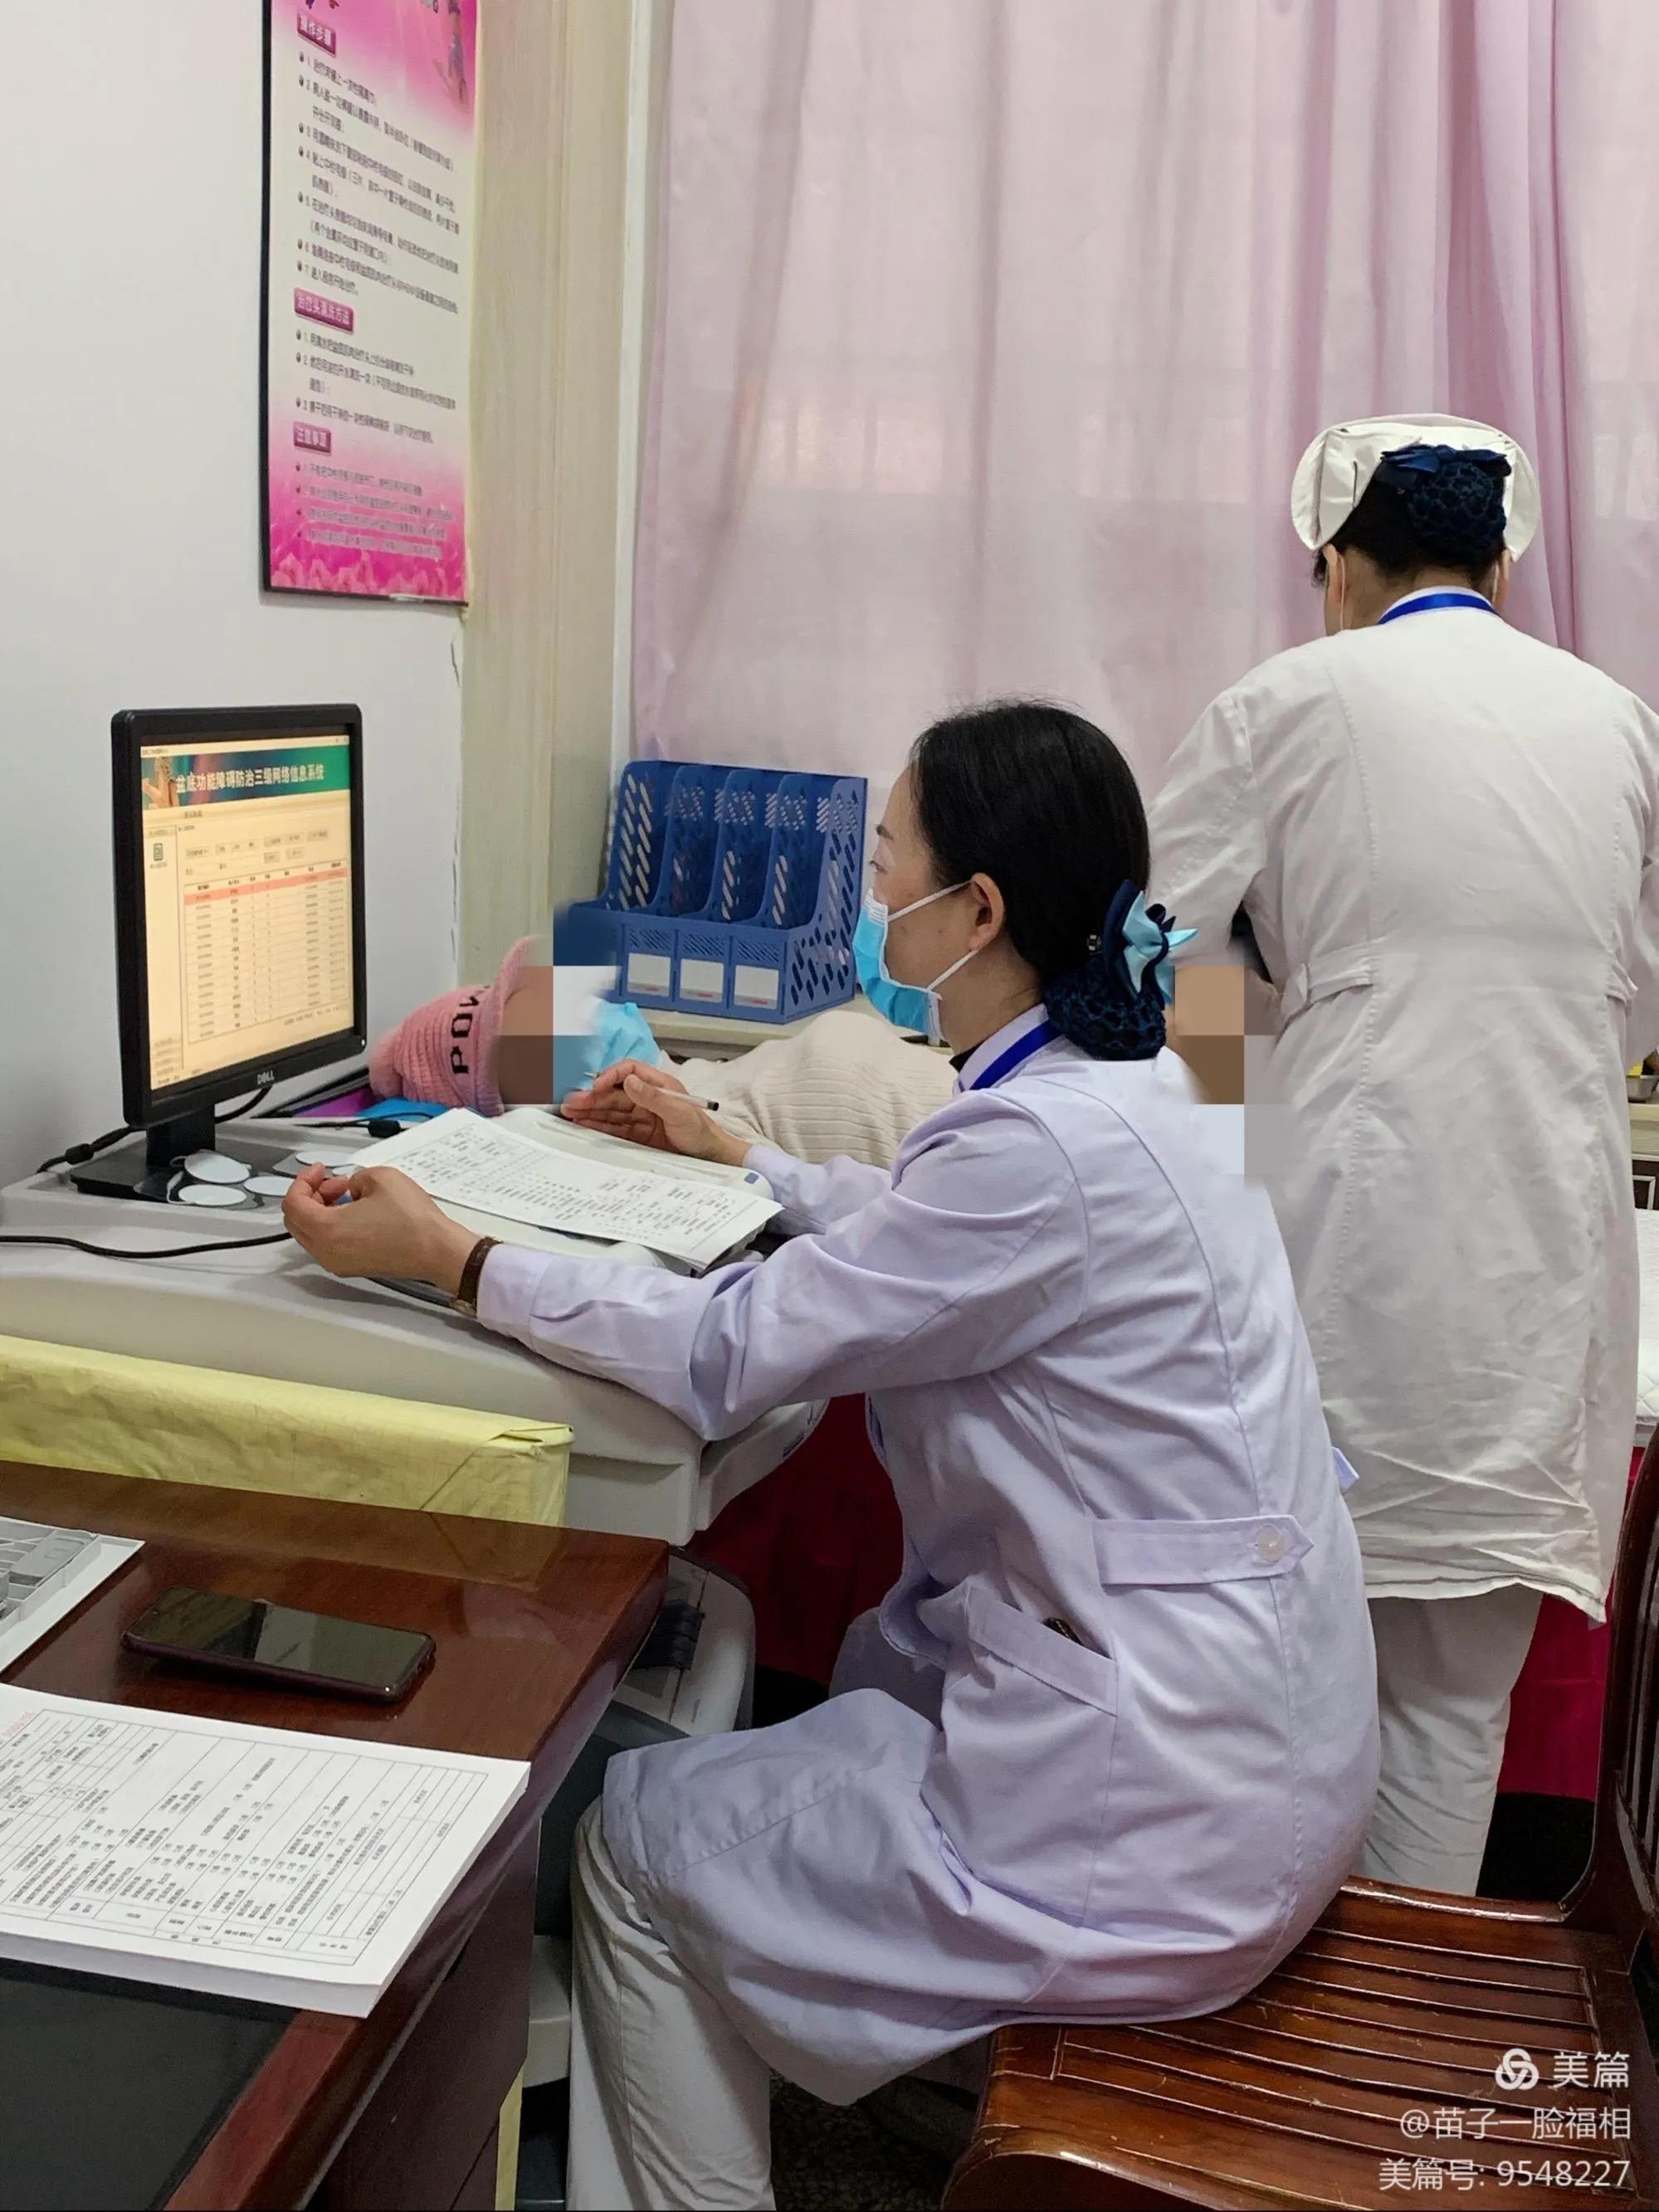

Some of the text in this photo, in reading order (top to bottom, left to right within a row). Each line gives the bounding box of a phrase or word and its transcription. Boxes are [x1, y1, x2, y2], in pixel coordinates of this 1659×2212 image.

[176, 763, 324, 793] 盆底功能障碍防治三级网络信息系统
